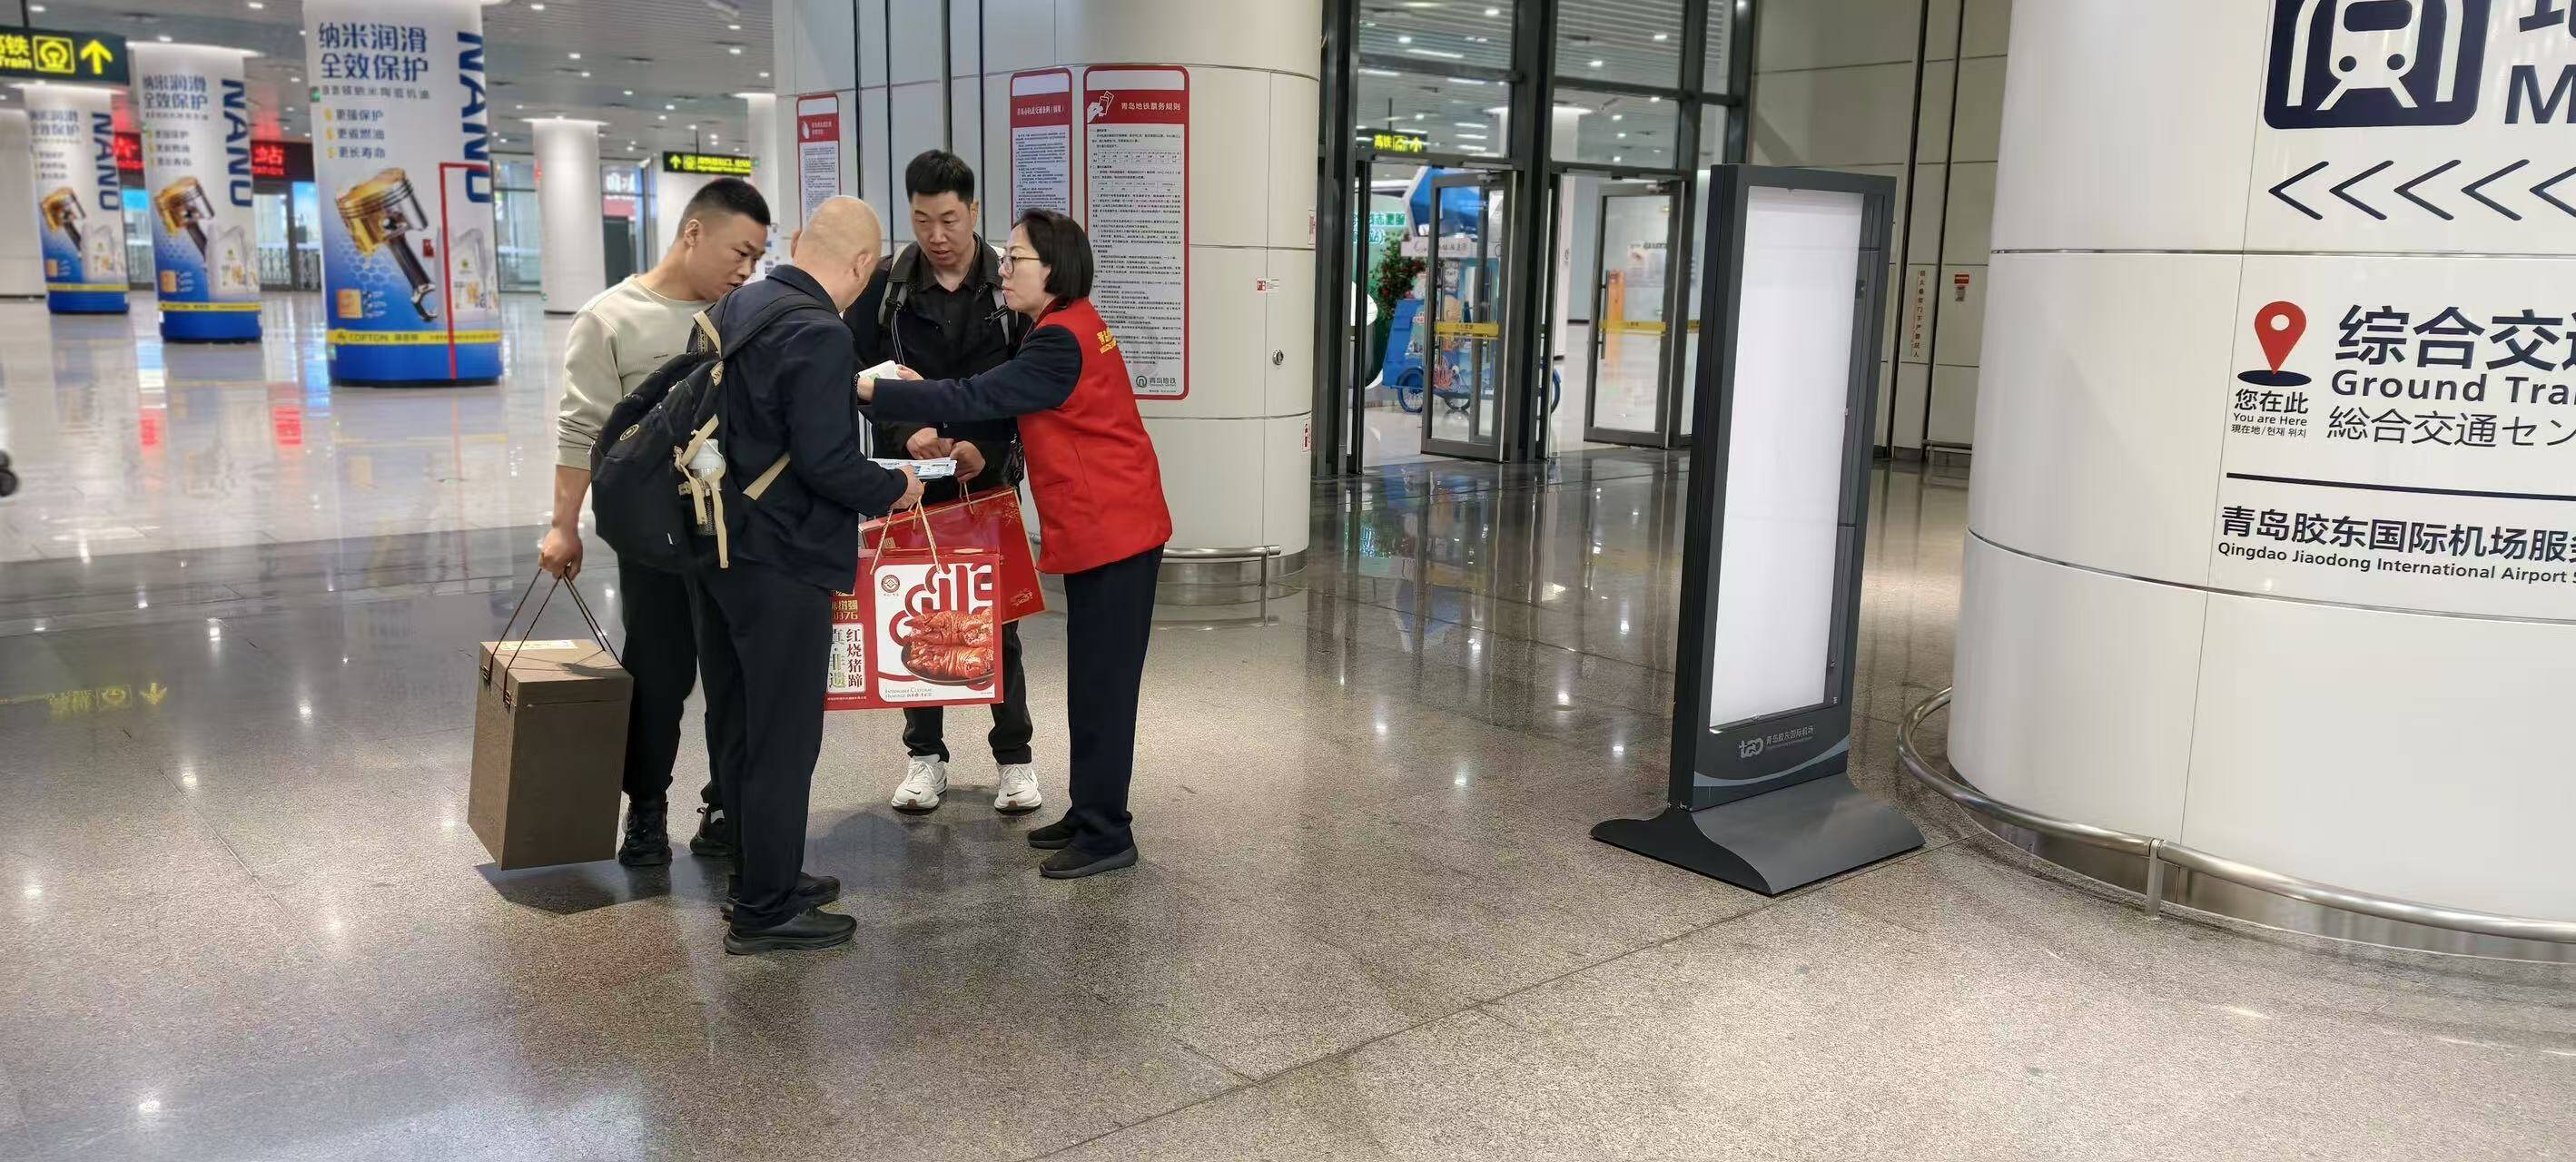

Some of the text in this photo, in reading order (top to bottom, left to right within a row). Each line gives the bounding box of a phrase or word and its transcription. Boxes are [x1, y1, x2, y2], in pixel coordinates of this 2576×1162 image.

[319, 22, 427, 53] 纳米润滑
[321, 53, 429, 82] 全效保护
[143, 92, 208, 110] 全效保护
[457, 31, 491, 204] NANO
[1120, 102, 1180, 111] 青岛地铁票务规则
[222, 78, 253, 208] NANO
[1374, 134, 1393, 151] 高铁
[92, 112, 120, 211] NANO
[2334, 304, 2576, 372] 综合交
[2234, 389, 2309, 414] 您在此
[2331, 369, 2576, 405] Ground Tra
[2233, 412, 2307, 426] You are Here
[2288, 428, 2306, 438] 위치
[2327, 406, 2576, 448] 総合交通セン
[2218, 542, 2287, 560] Qingdao
[2293, 550, 2371, 572] Jiaodong
[2377, 557, 2496, 578] International
[2501, 566, 2568, 584] Airport
[846, 628, 863, 687] 红烧猪蹄
